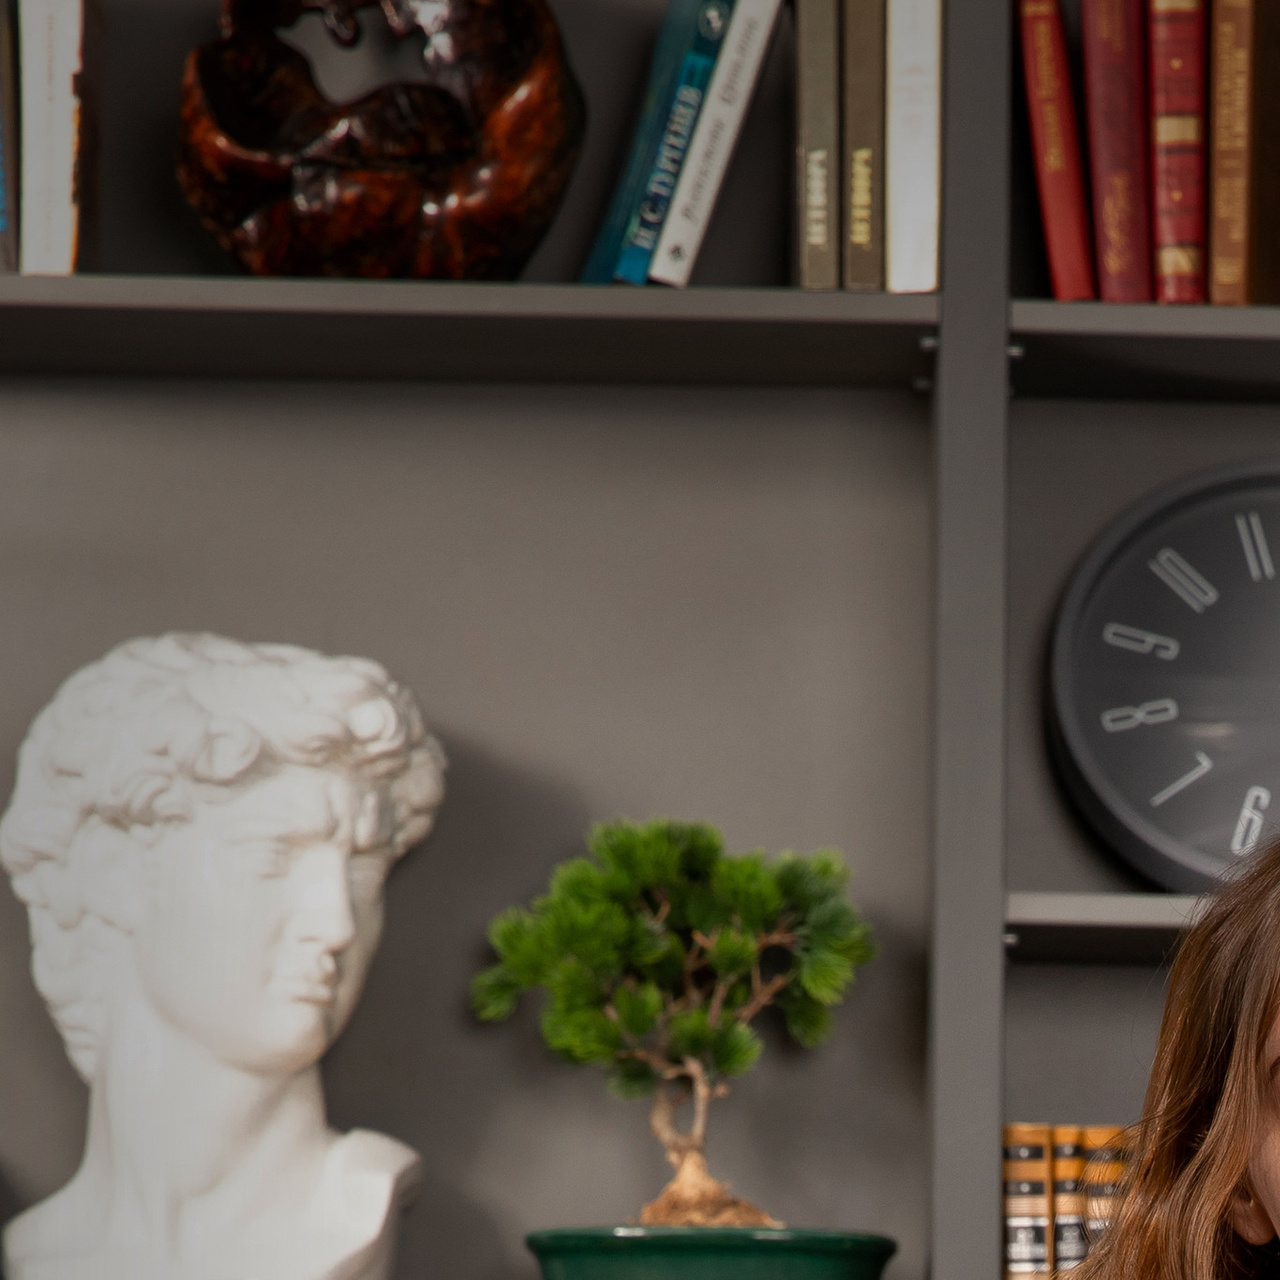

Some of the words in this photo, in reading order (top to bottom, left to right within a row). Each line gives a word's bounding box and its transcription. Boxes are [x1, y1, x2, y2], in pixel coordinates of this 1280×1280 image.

[1234, 511, 1276, 583] 11
[1147, 546, 1220, 614] 10
[1102, 622, 1181, 661] 9
[1100, 699, 1180, 733] 8
[1149, 751, 1214, 808] 7
[1230, 785, 1272, 857] 6
